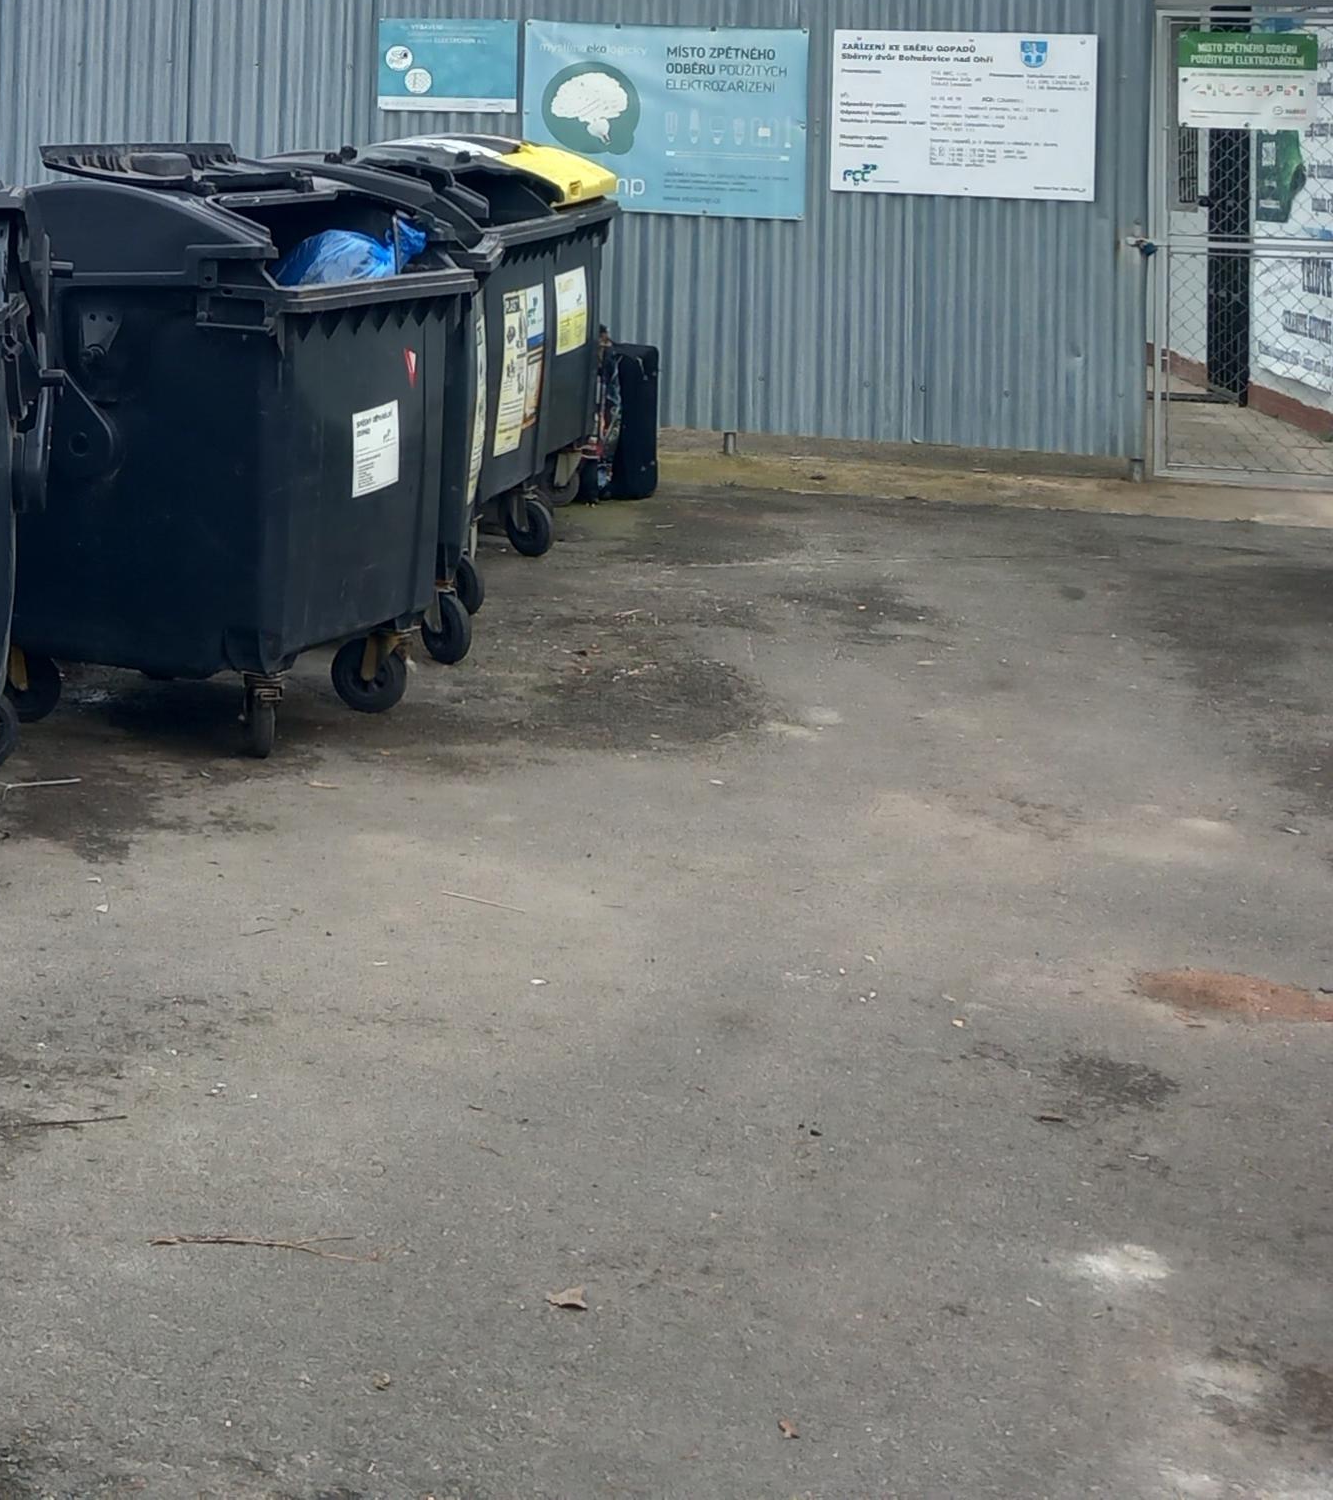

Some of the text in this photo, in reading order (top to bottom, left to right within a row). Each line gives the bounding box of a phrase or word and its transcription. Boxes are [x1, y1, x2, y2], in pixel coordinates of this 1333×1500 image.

[841, 42, 886, 51] ZAŘÍZENÍ
[888, 43, 900, 51] KE
[666, 45, 776, 61] MÍSTO ZPĚTNÉHO
[841, 53, 873, 61] Sběrný
[875, 53, 896, 61] dvůr
[898, 54, 951, 62] Bohušovice
[953, 55, 971, 63] nad
[665, 61, 715, 76] ODBĚRU
